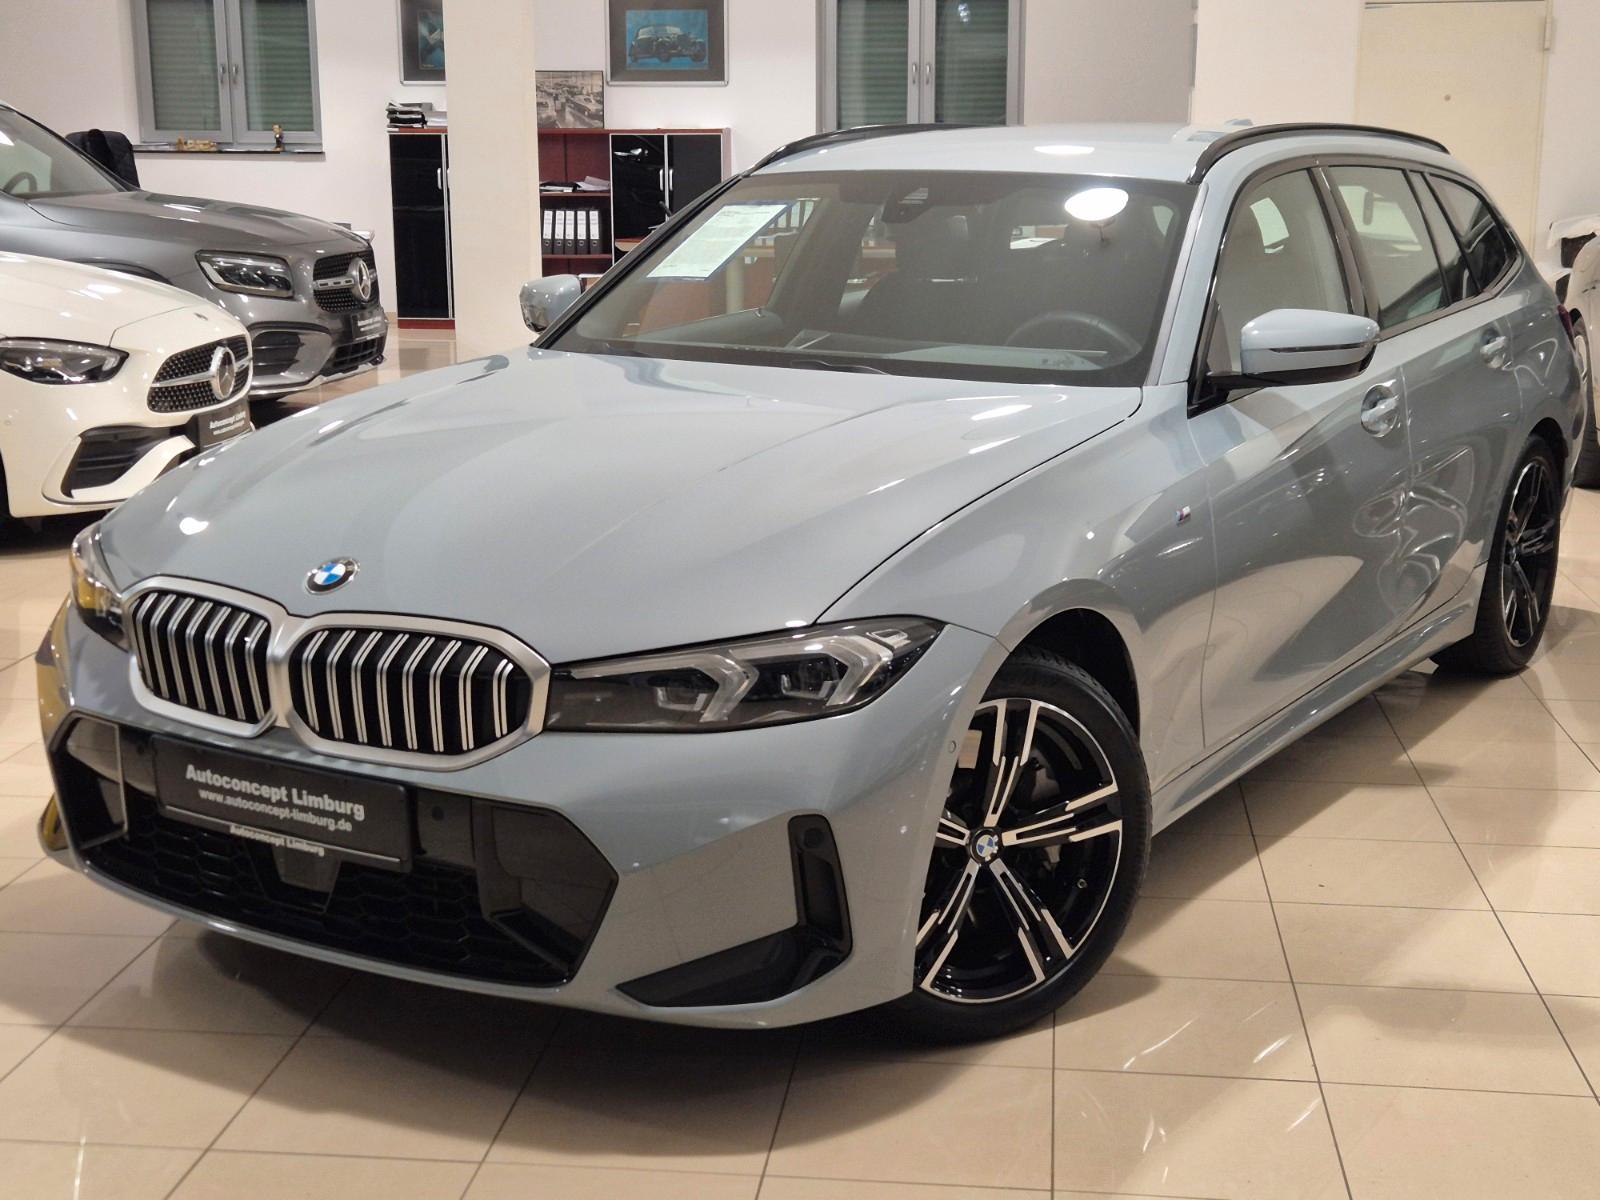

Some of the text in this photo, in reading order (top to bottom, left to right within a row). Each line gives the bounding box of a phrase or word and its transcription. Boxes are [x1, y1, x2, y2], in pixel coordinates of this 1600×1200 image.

[185, 764, 365, 821] Autoconcept Limburg
[198, 788, 352, 832] www.autoconcept-limburg.de
